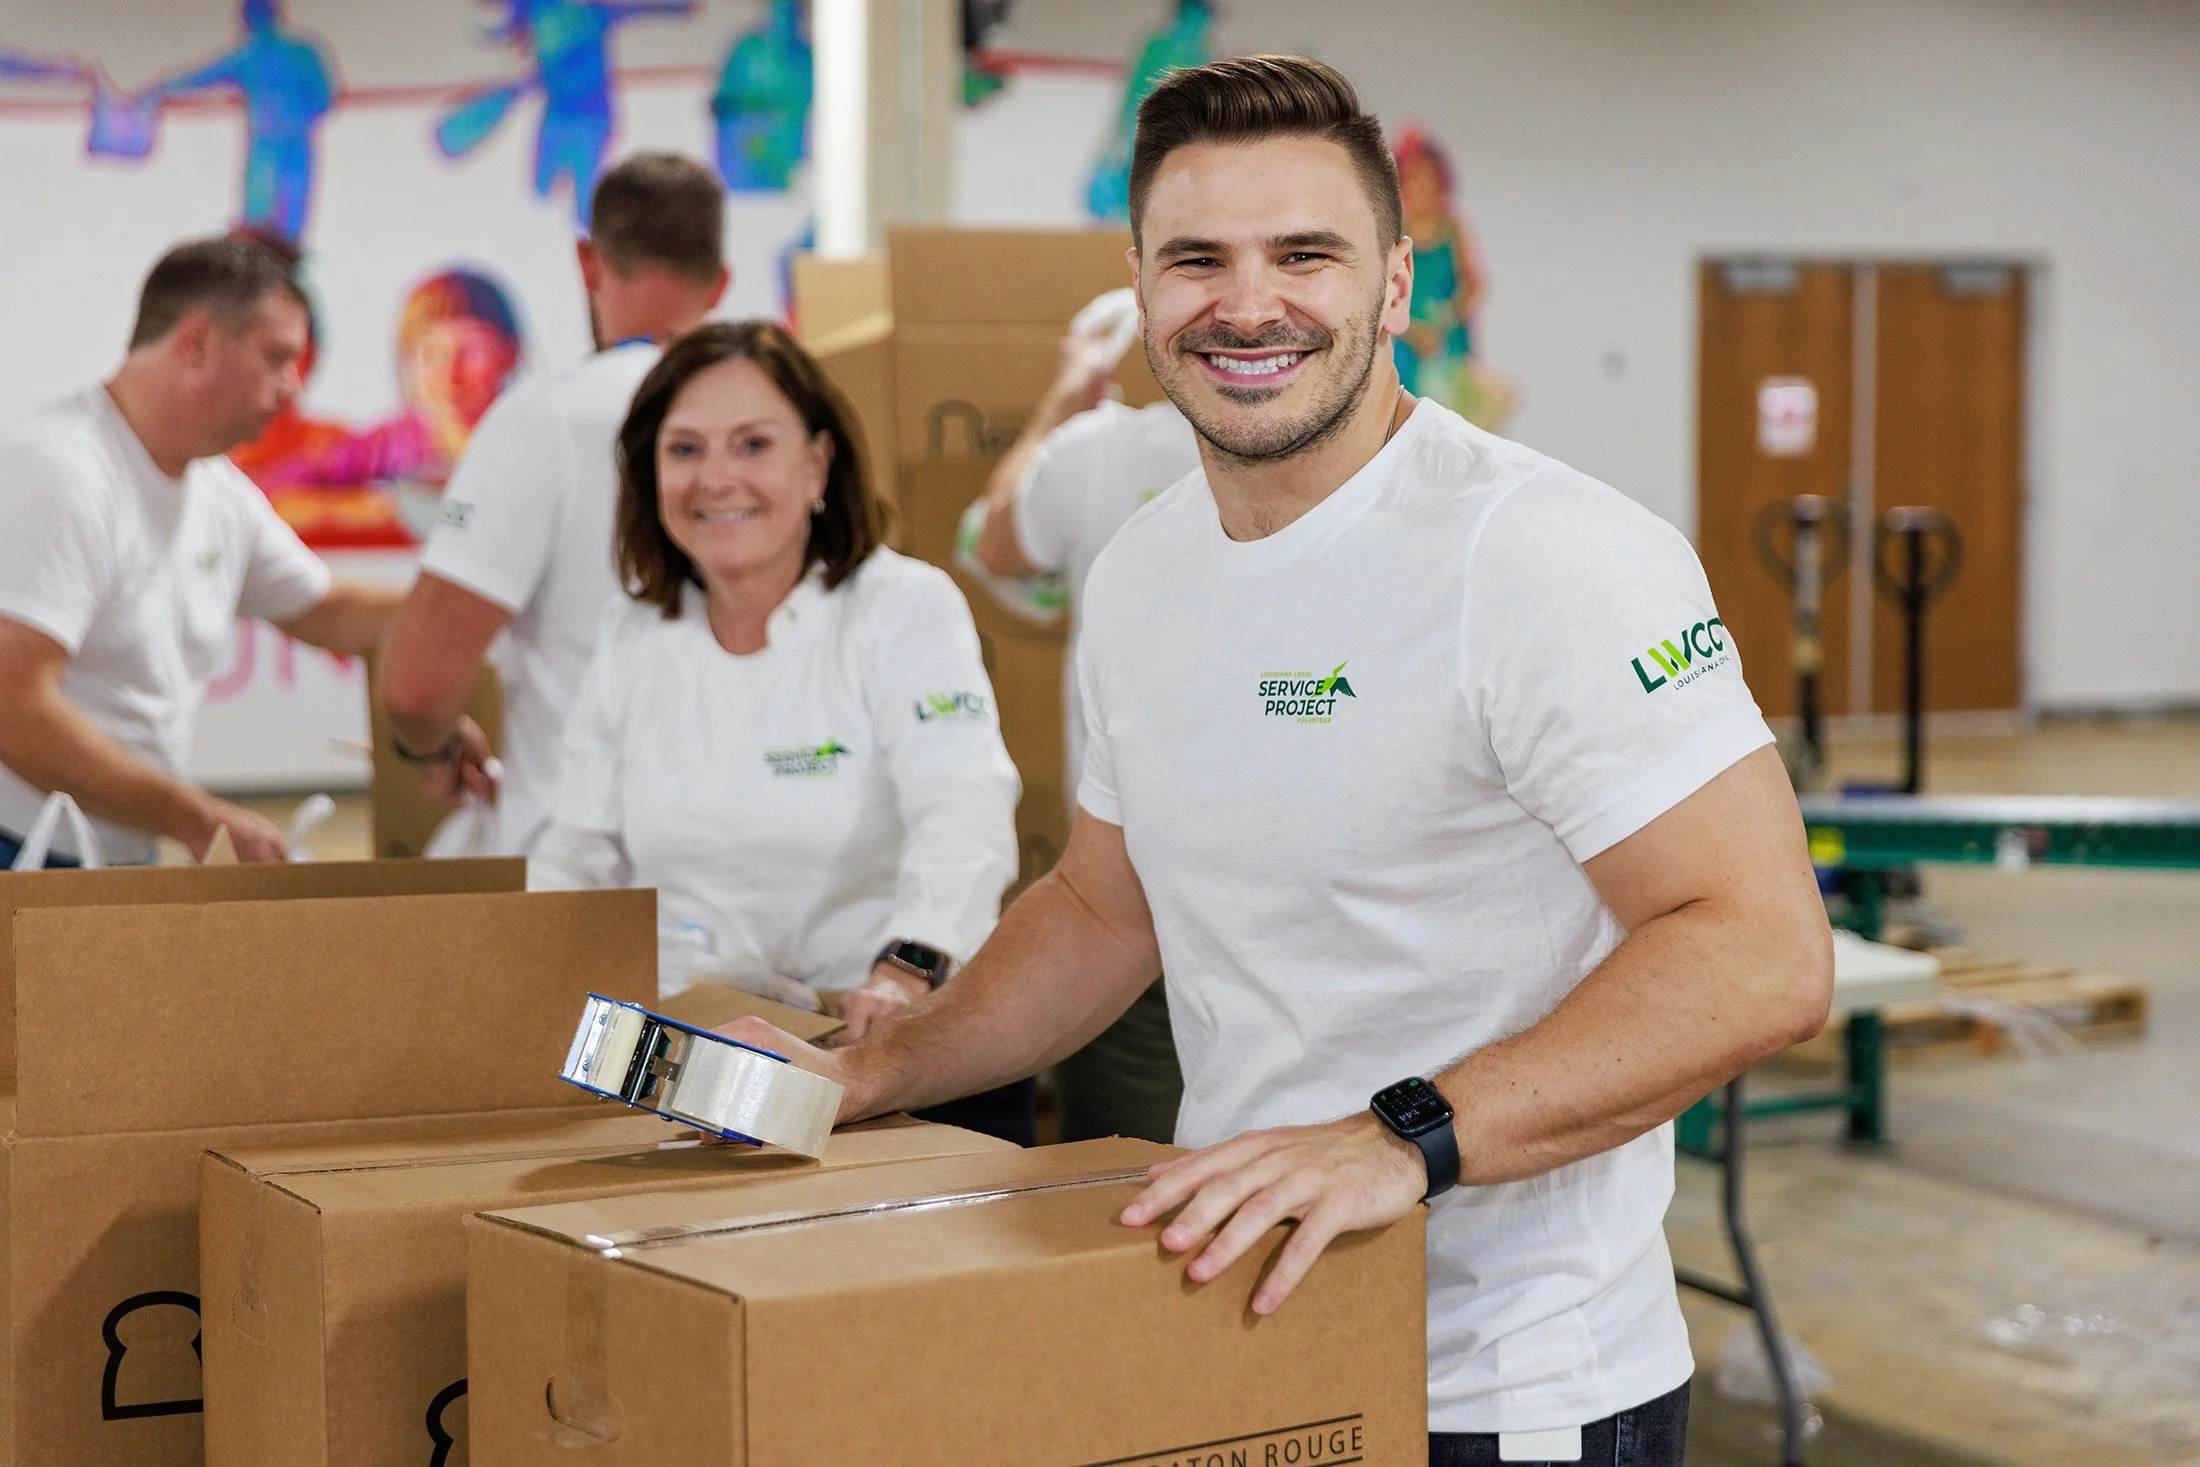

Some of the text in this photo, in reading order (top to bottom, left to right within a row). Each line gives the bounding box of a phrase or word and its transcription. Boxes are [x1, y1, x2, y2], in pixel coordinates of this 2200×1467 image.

[1631, 617, 1724, 694] LWCC
[1258, 680, 1326, 697] SERVICE
[1672, 661, 1720, 691] LOUISIANA
[1264, 699, 1337, 716] PROJECT
[1265, 1425, 1363, 1467] ROUGE
